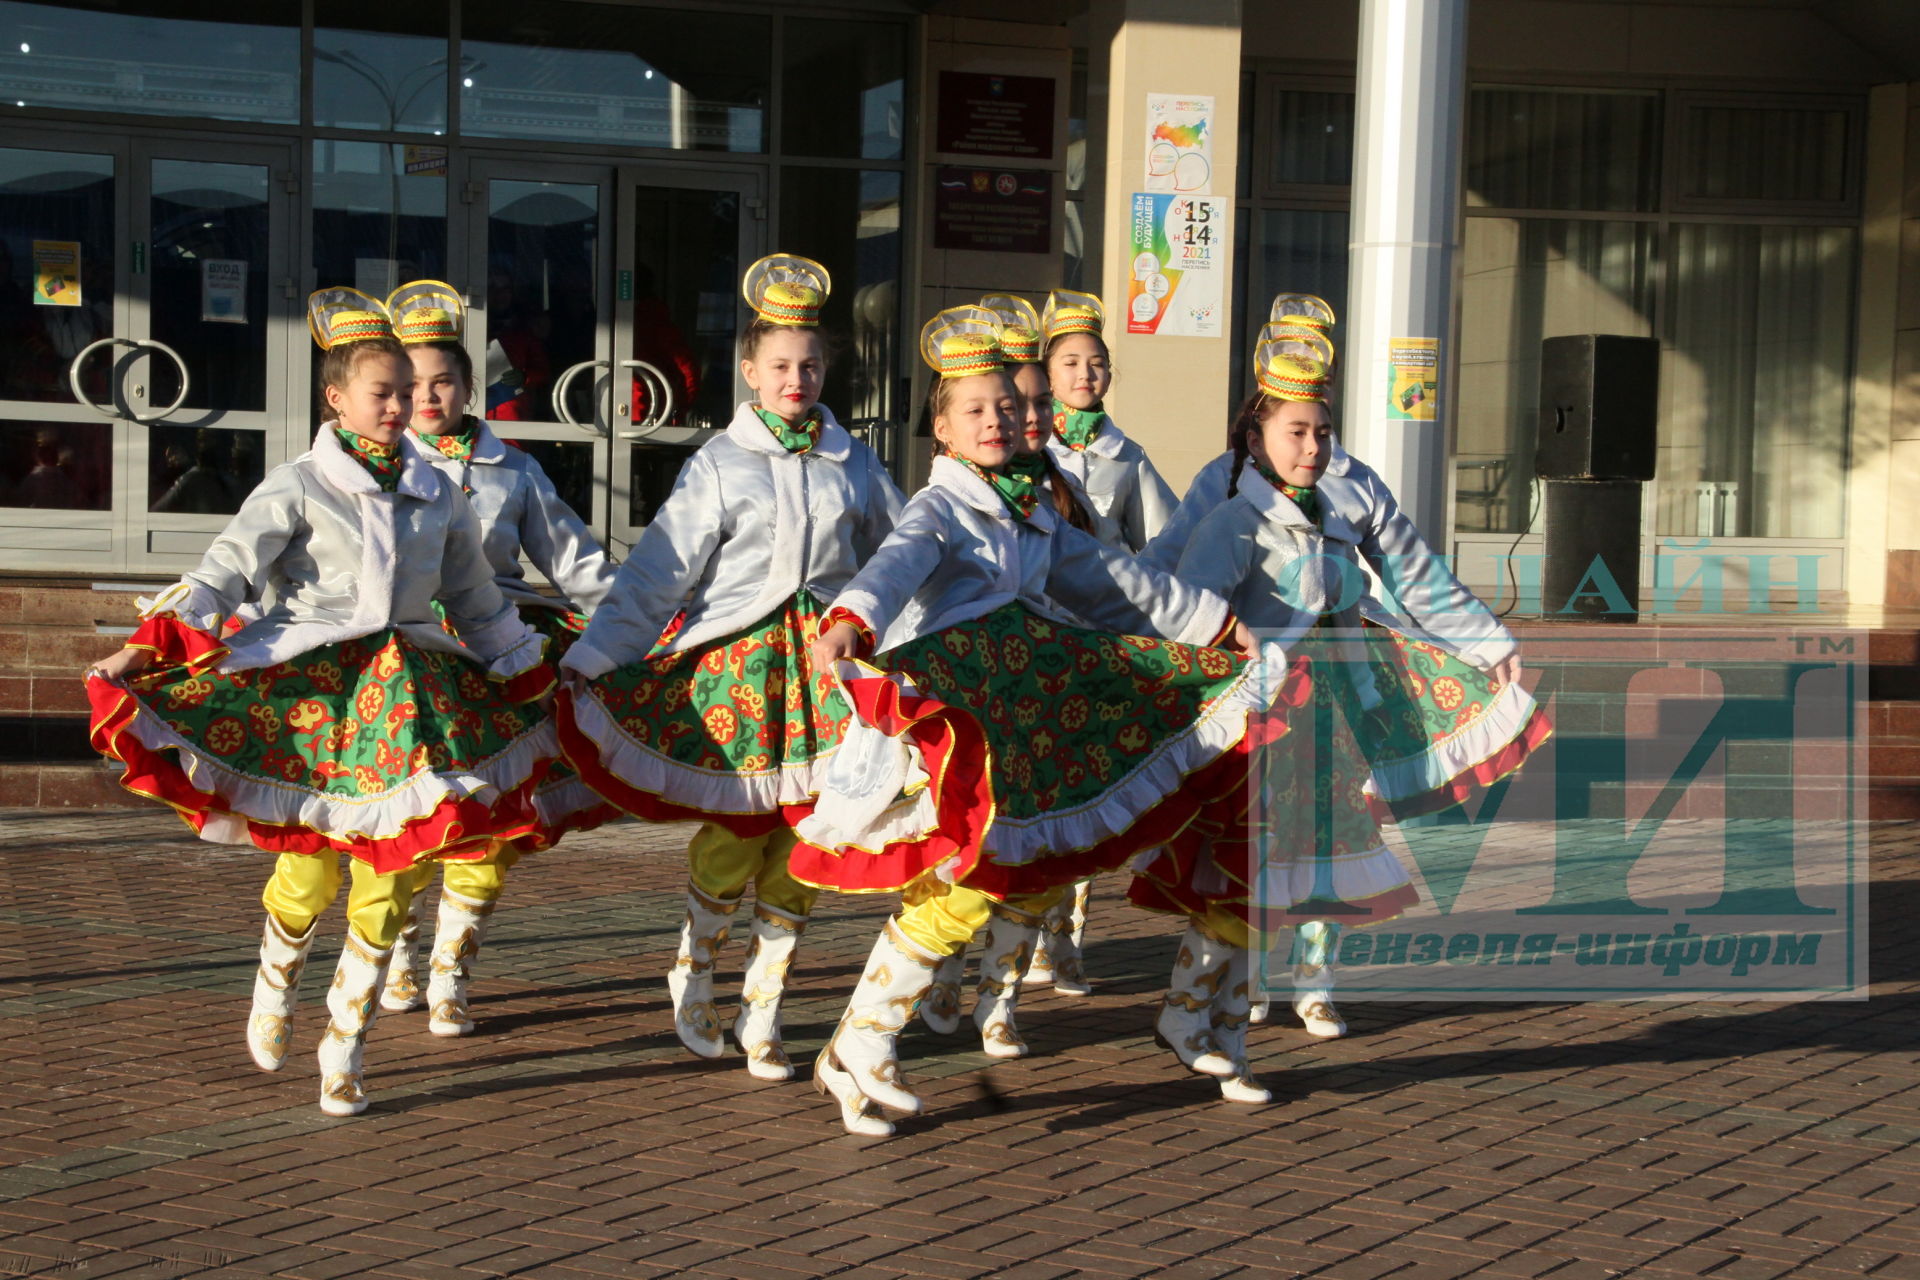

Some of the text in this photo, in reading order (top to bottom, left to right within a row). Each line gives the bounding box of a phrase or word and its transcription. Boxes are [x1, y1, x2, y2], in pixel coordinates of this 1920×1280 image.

[1134, 195, 1145, 244] СОЗДАЁМ
[1143, 195, 1153, 249] БУДУЩЕЕ!
[1185, 201, 1211, 223] 15
[1185, 224, 1211, 246] 14
[1182, 246, 1211, 259] 2021
[208, 263, 241, 276] ВХОД
